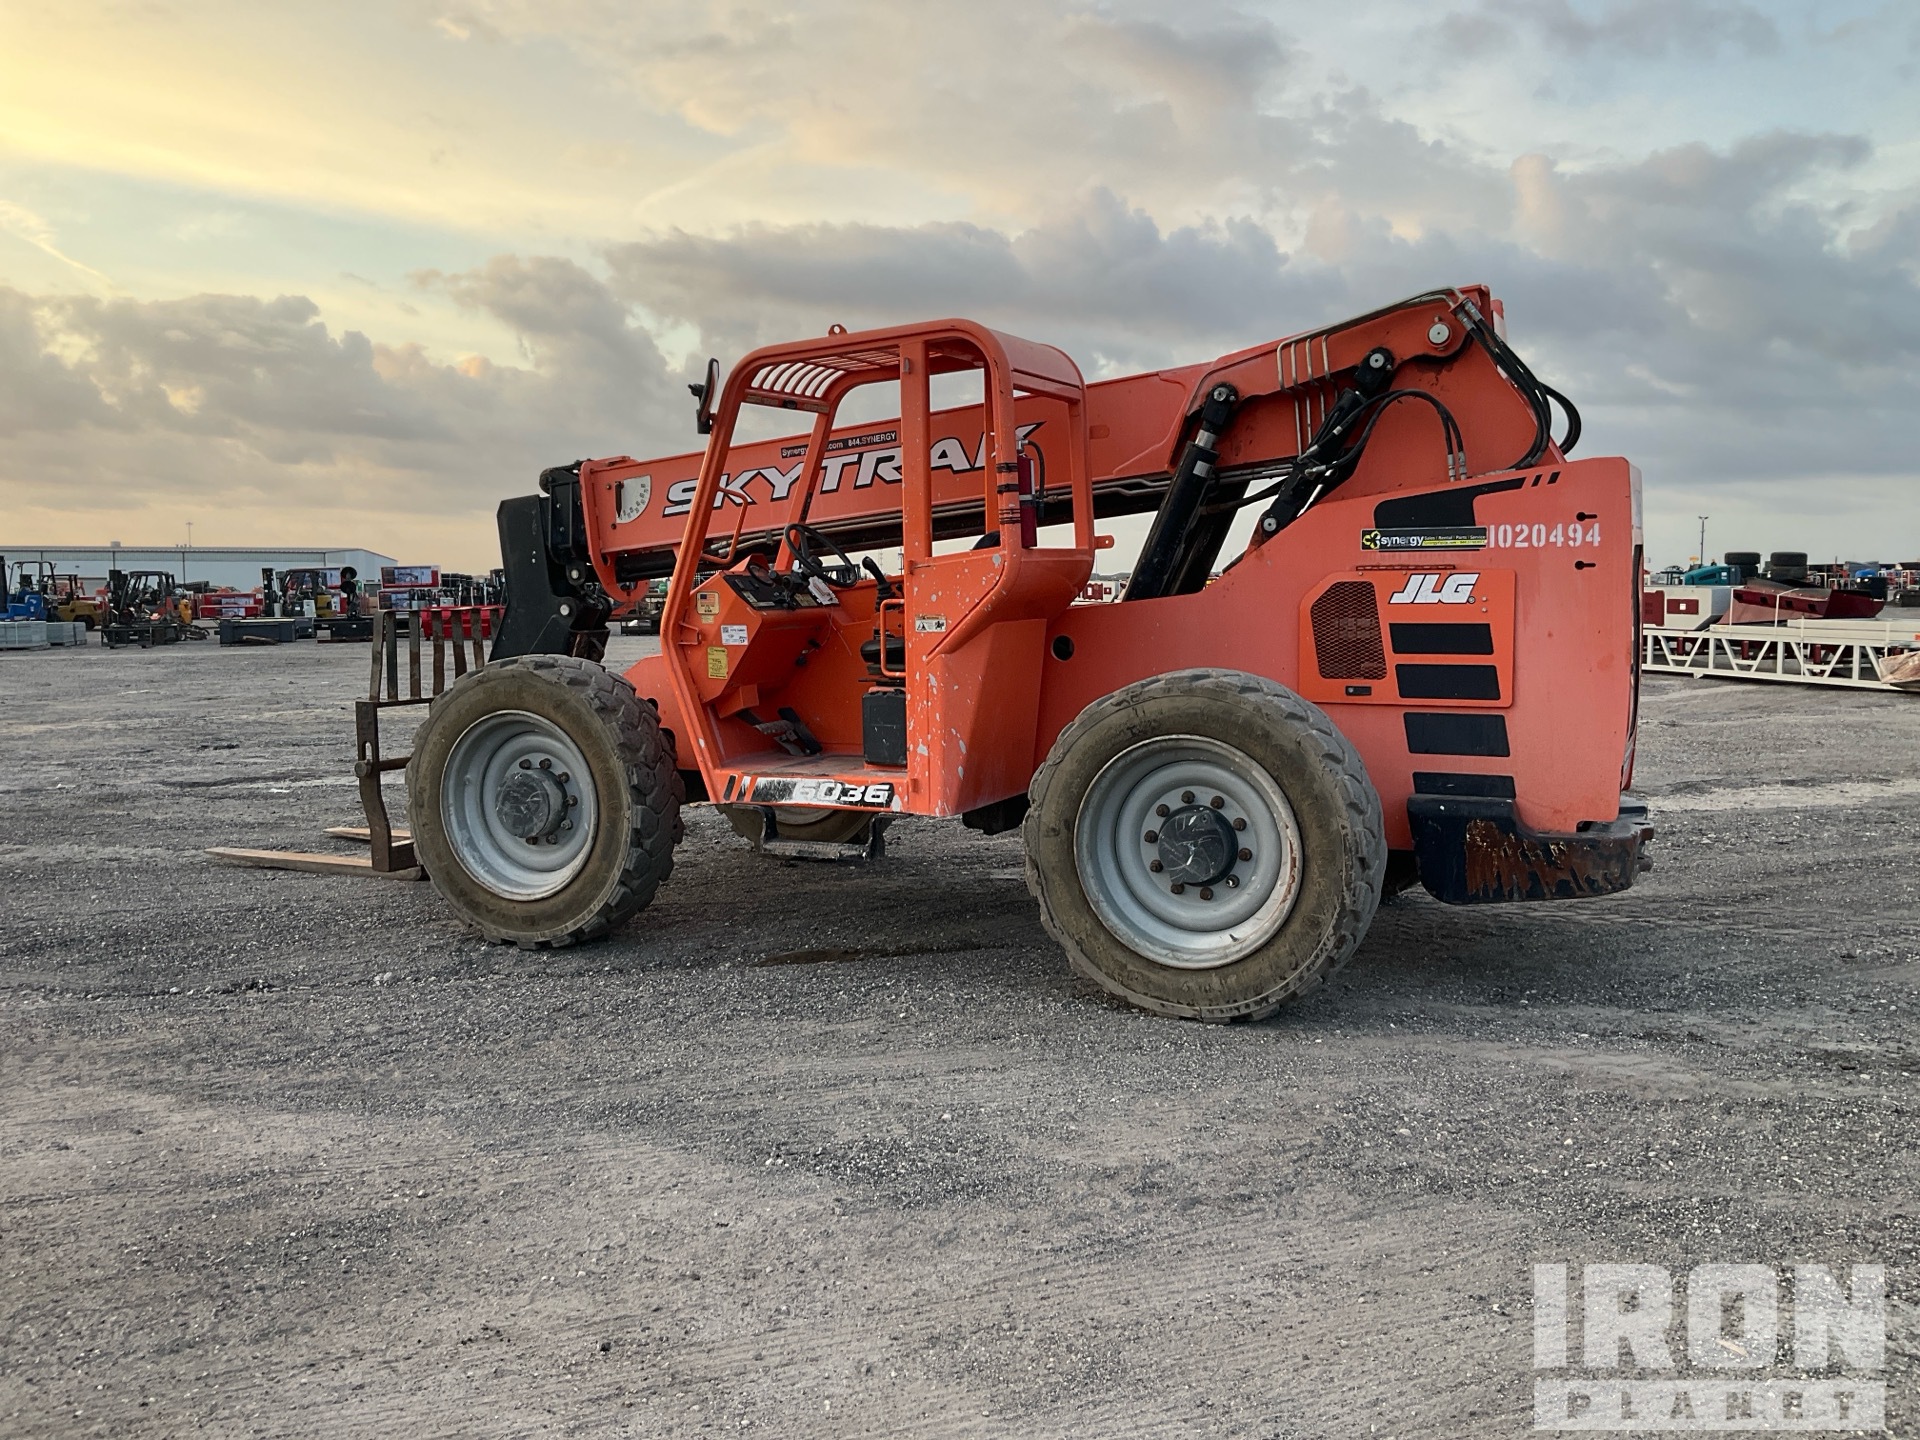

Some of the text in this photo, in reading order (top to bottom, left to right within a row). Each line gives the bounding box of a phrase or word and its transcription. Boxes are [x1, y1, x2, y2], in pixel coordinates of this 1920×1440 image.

[1380, 535, 1424, 547] synergy
[1489, 523, 1601, 548] 1020494
[1388, 573, 1480, 604] JLG
